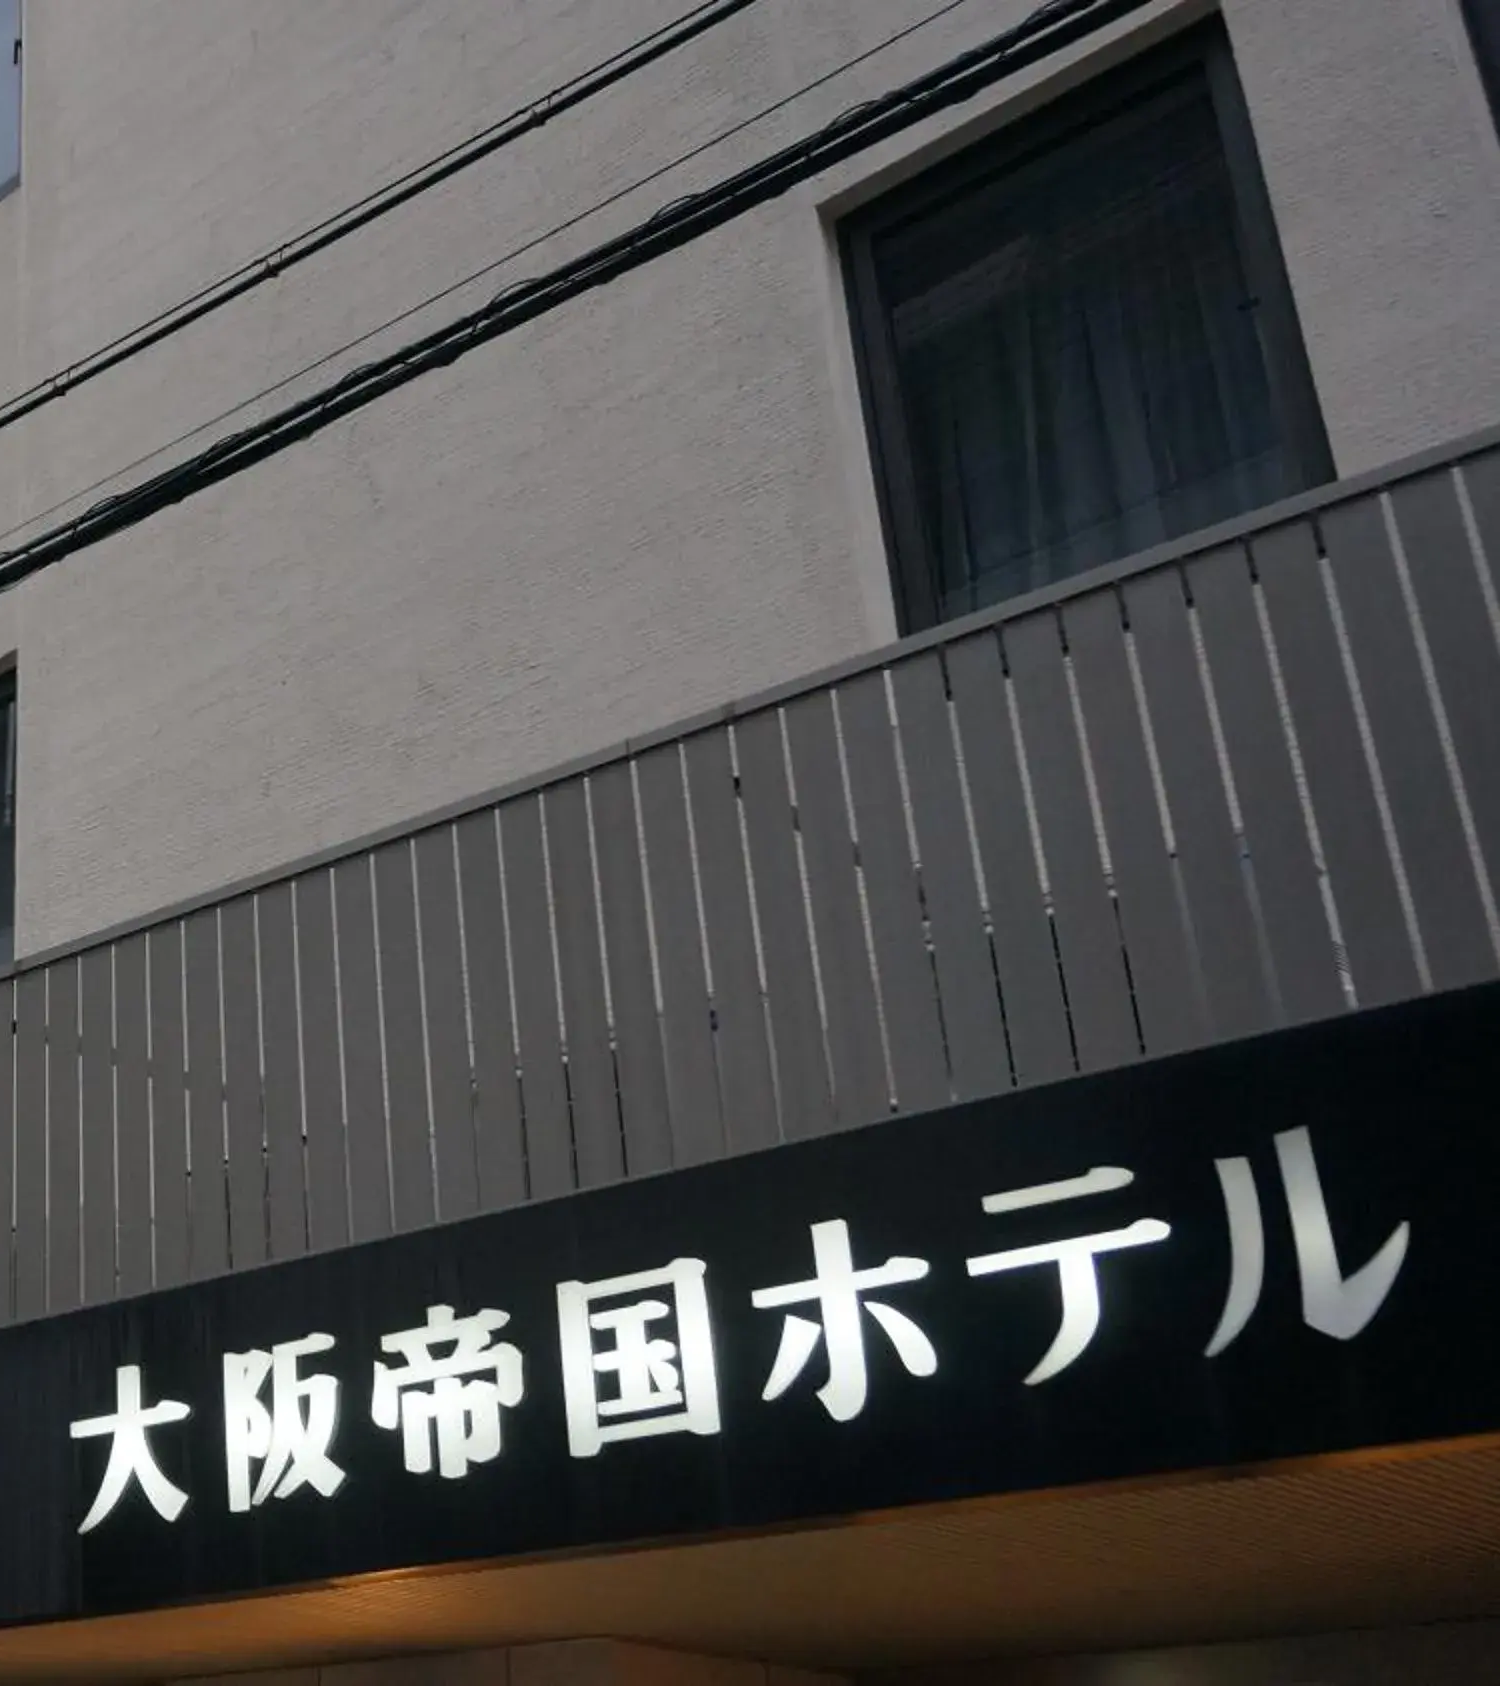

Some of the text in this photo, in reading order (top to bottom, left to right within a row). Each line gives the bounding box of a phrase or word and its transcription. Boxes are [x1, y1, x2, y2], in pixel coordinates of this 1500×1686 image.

[69, 1126, 1411, 1534] 大阪帝国ホテル
